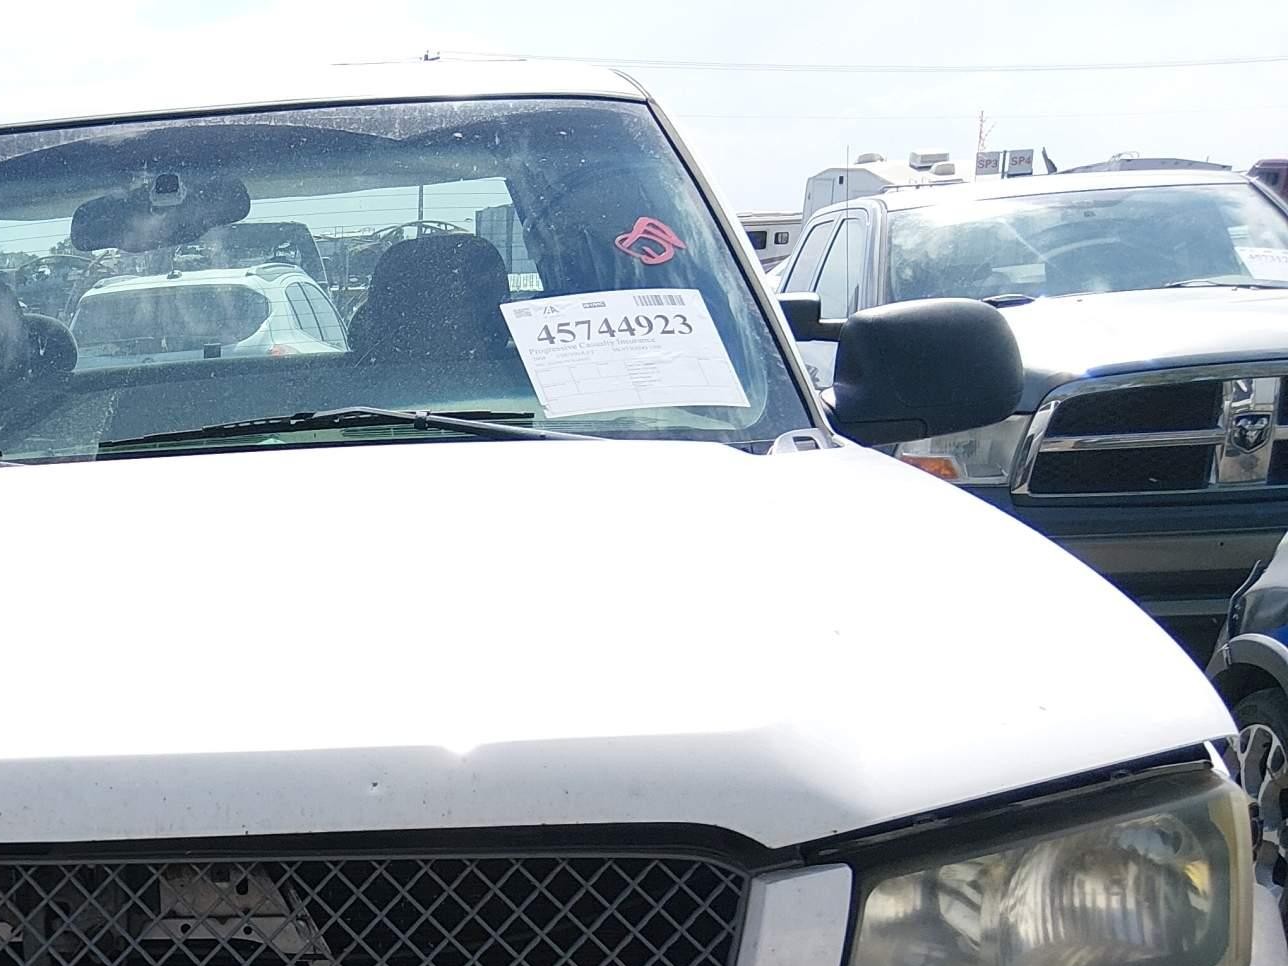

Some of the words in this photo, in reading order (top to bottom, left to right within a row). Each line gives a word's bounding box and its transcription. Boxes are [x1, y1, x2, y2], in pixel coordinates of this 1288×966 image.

[977, 159, 998, 169] SP3
[1011, 156, 1032, 166] SP4
[537, 314, 693, 344] 45744923
